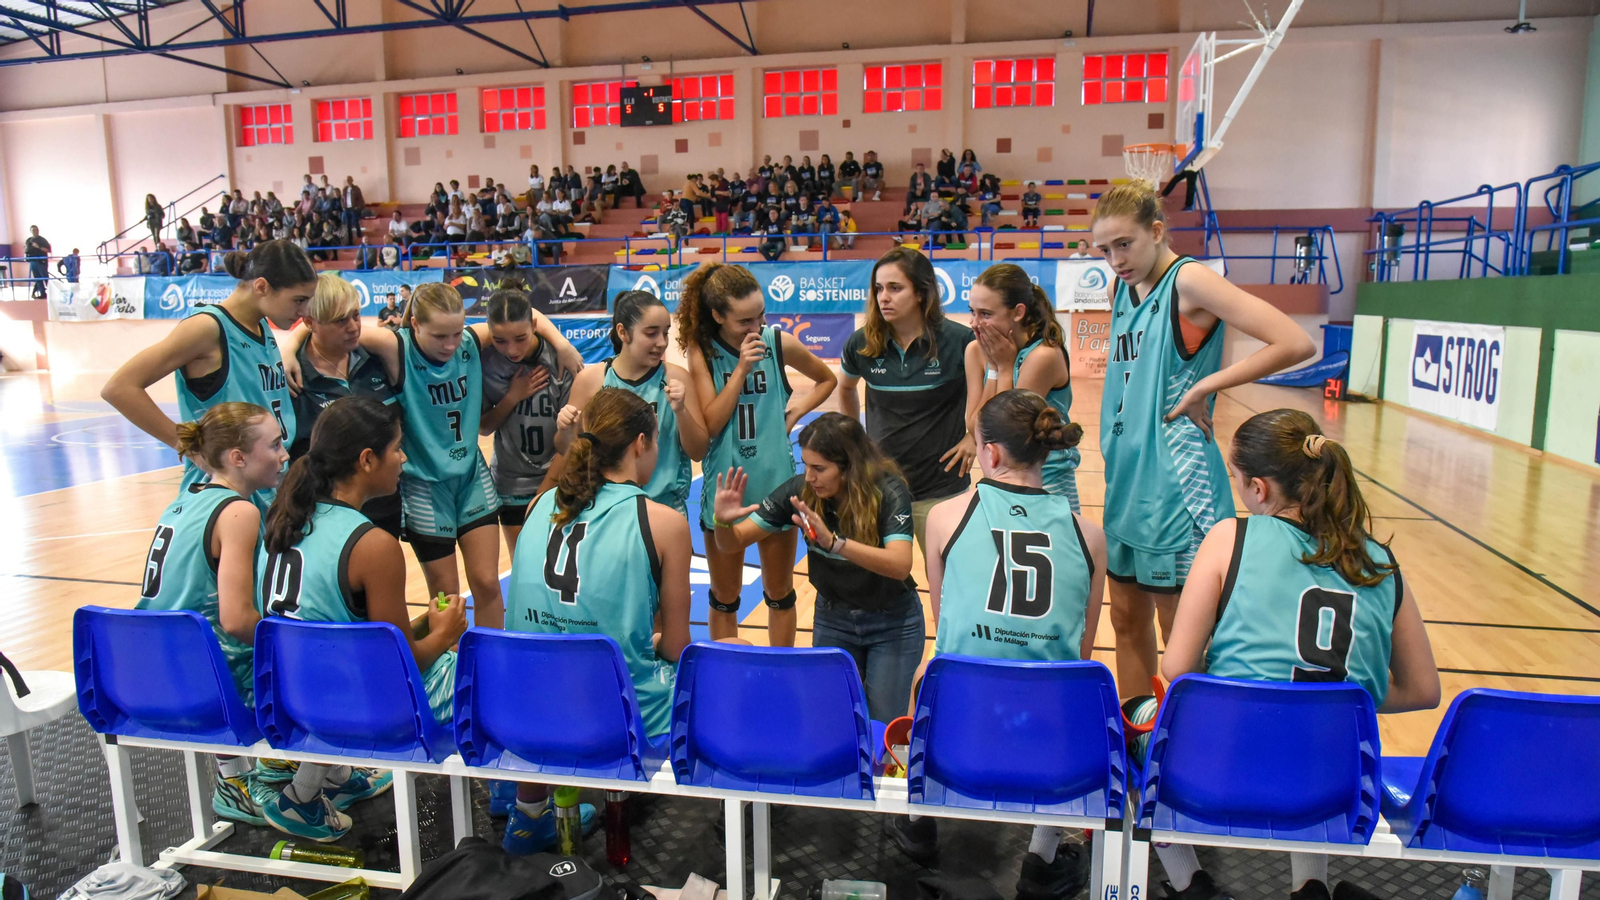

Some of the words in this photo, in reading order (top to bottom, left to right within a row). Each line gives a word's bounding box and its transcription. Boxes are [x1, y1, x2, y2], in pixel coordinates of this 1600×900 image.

[626, 104, 632, 114] 5
[658, 103, 664, 112] 5
[800, 277, 846, 289] BASKET
[799, 289, 869, 301] SOSTENIBL
[1077, 320, 1110, 334] Bar
[805, 335, 831, 344] Seguros
[1077, 336, 1111, 353] Tap
[870, 366, 887, 374] vive
[1442, 336, 1500, 405] STROG
[1324, 378, 1341, 398] 24
[738, 403, 756, 441] 11
[520, 424, 545, 455] 10
[543, 521, 590, 606] 4
[984, 527, 1055, 620] 15
[568, 618, 598, 628] Provincial
[994, 627, 1030, 639] Diputación
[1031, 632, 1060, 640] Provincial
[1290, 584, 1357, 683] 9
[1003, 637, 1028, 647] Málaga
